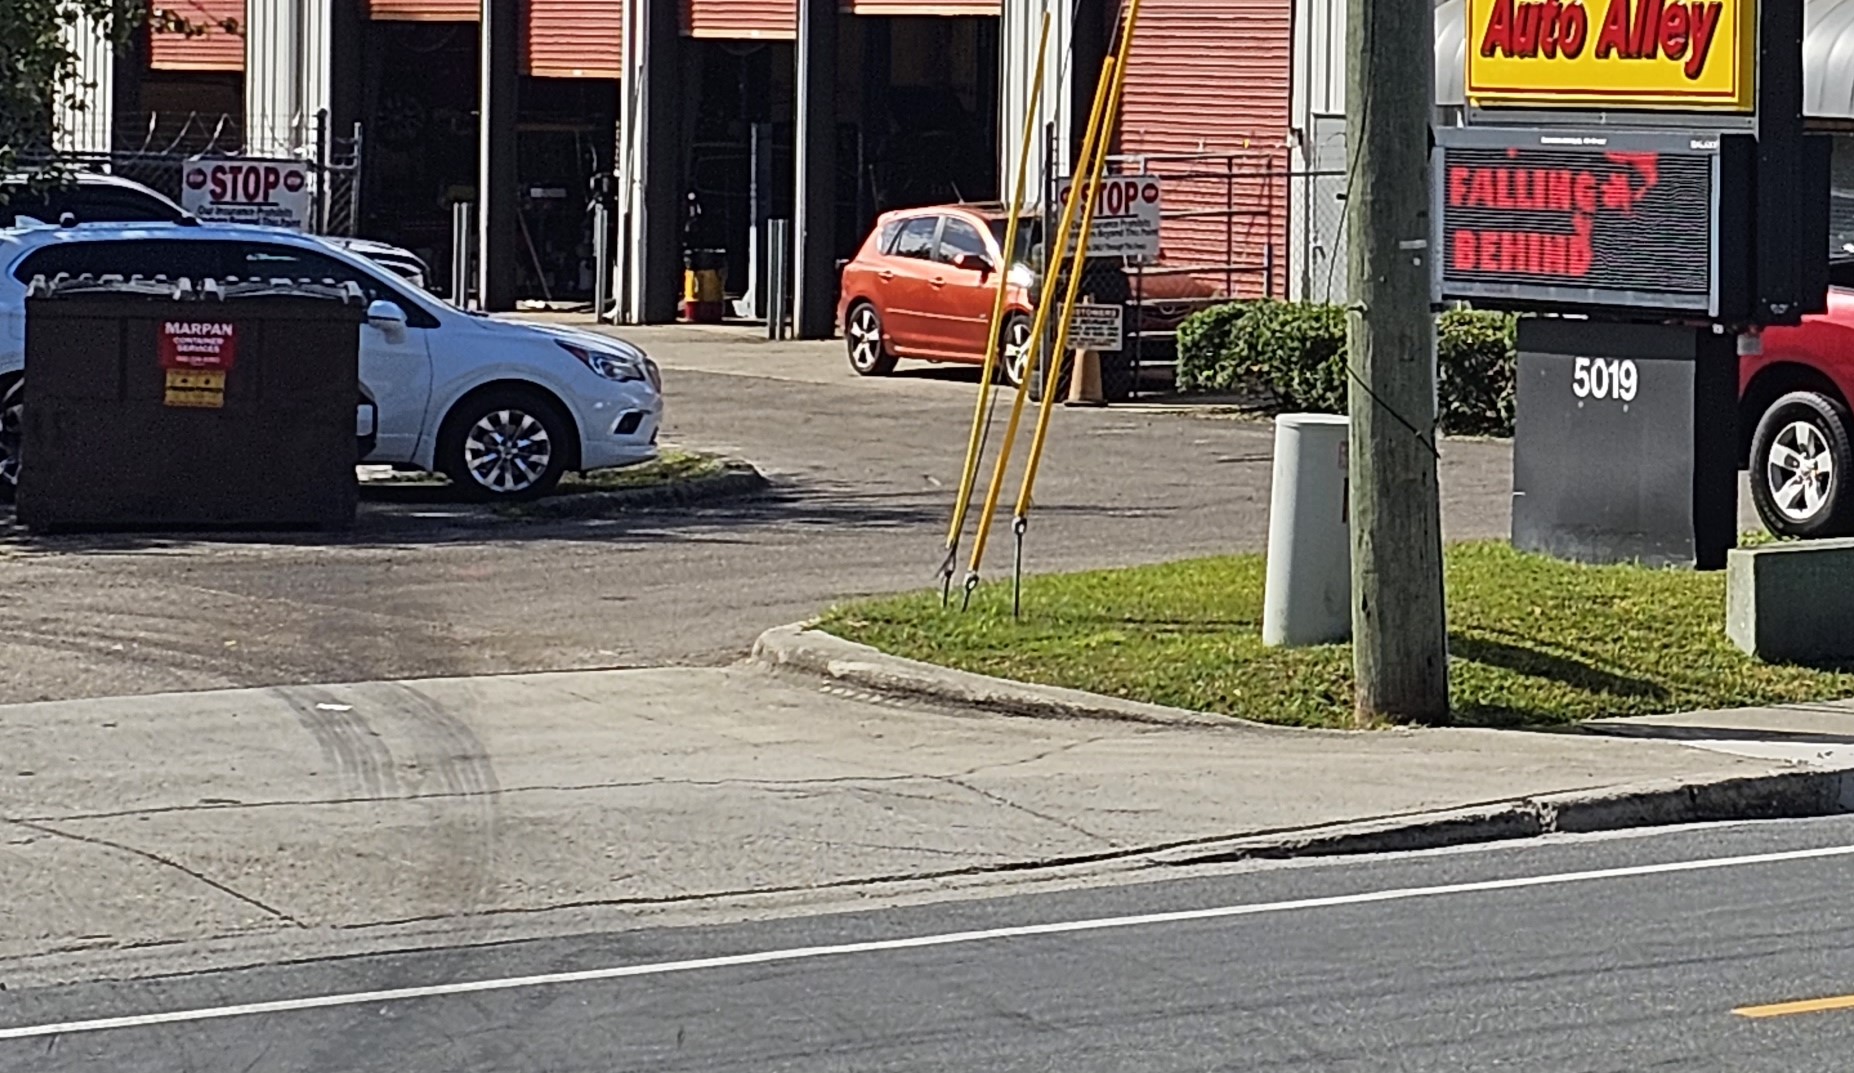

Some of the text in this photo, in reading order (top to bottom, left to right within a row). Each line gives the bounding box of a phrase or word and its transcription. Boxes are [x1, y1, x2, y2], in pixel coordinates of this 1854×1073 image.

[209, 165, 280, 202] STOP
[1449, 165, 1596, 214] FALLING
[1453, 229, 1592, 277] BEHIND
[164, 321, 233, 336] MARPAN
[1572, 357, 1638, 402] 5019
